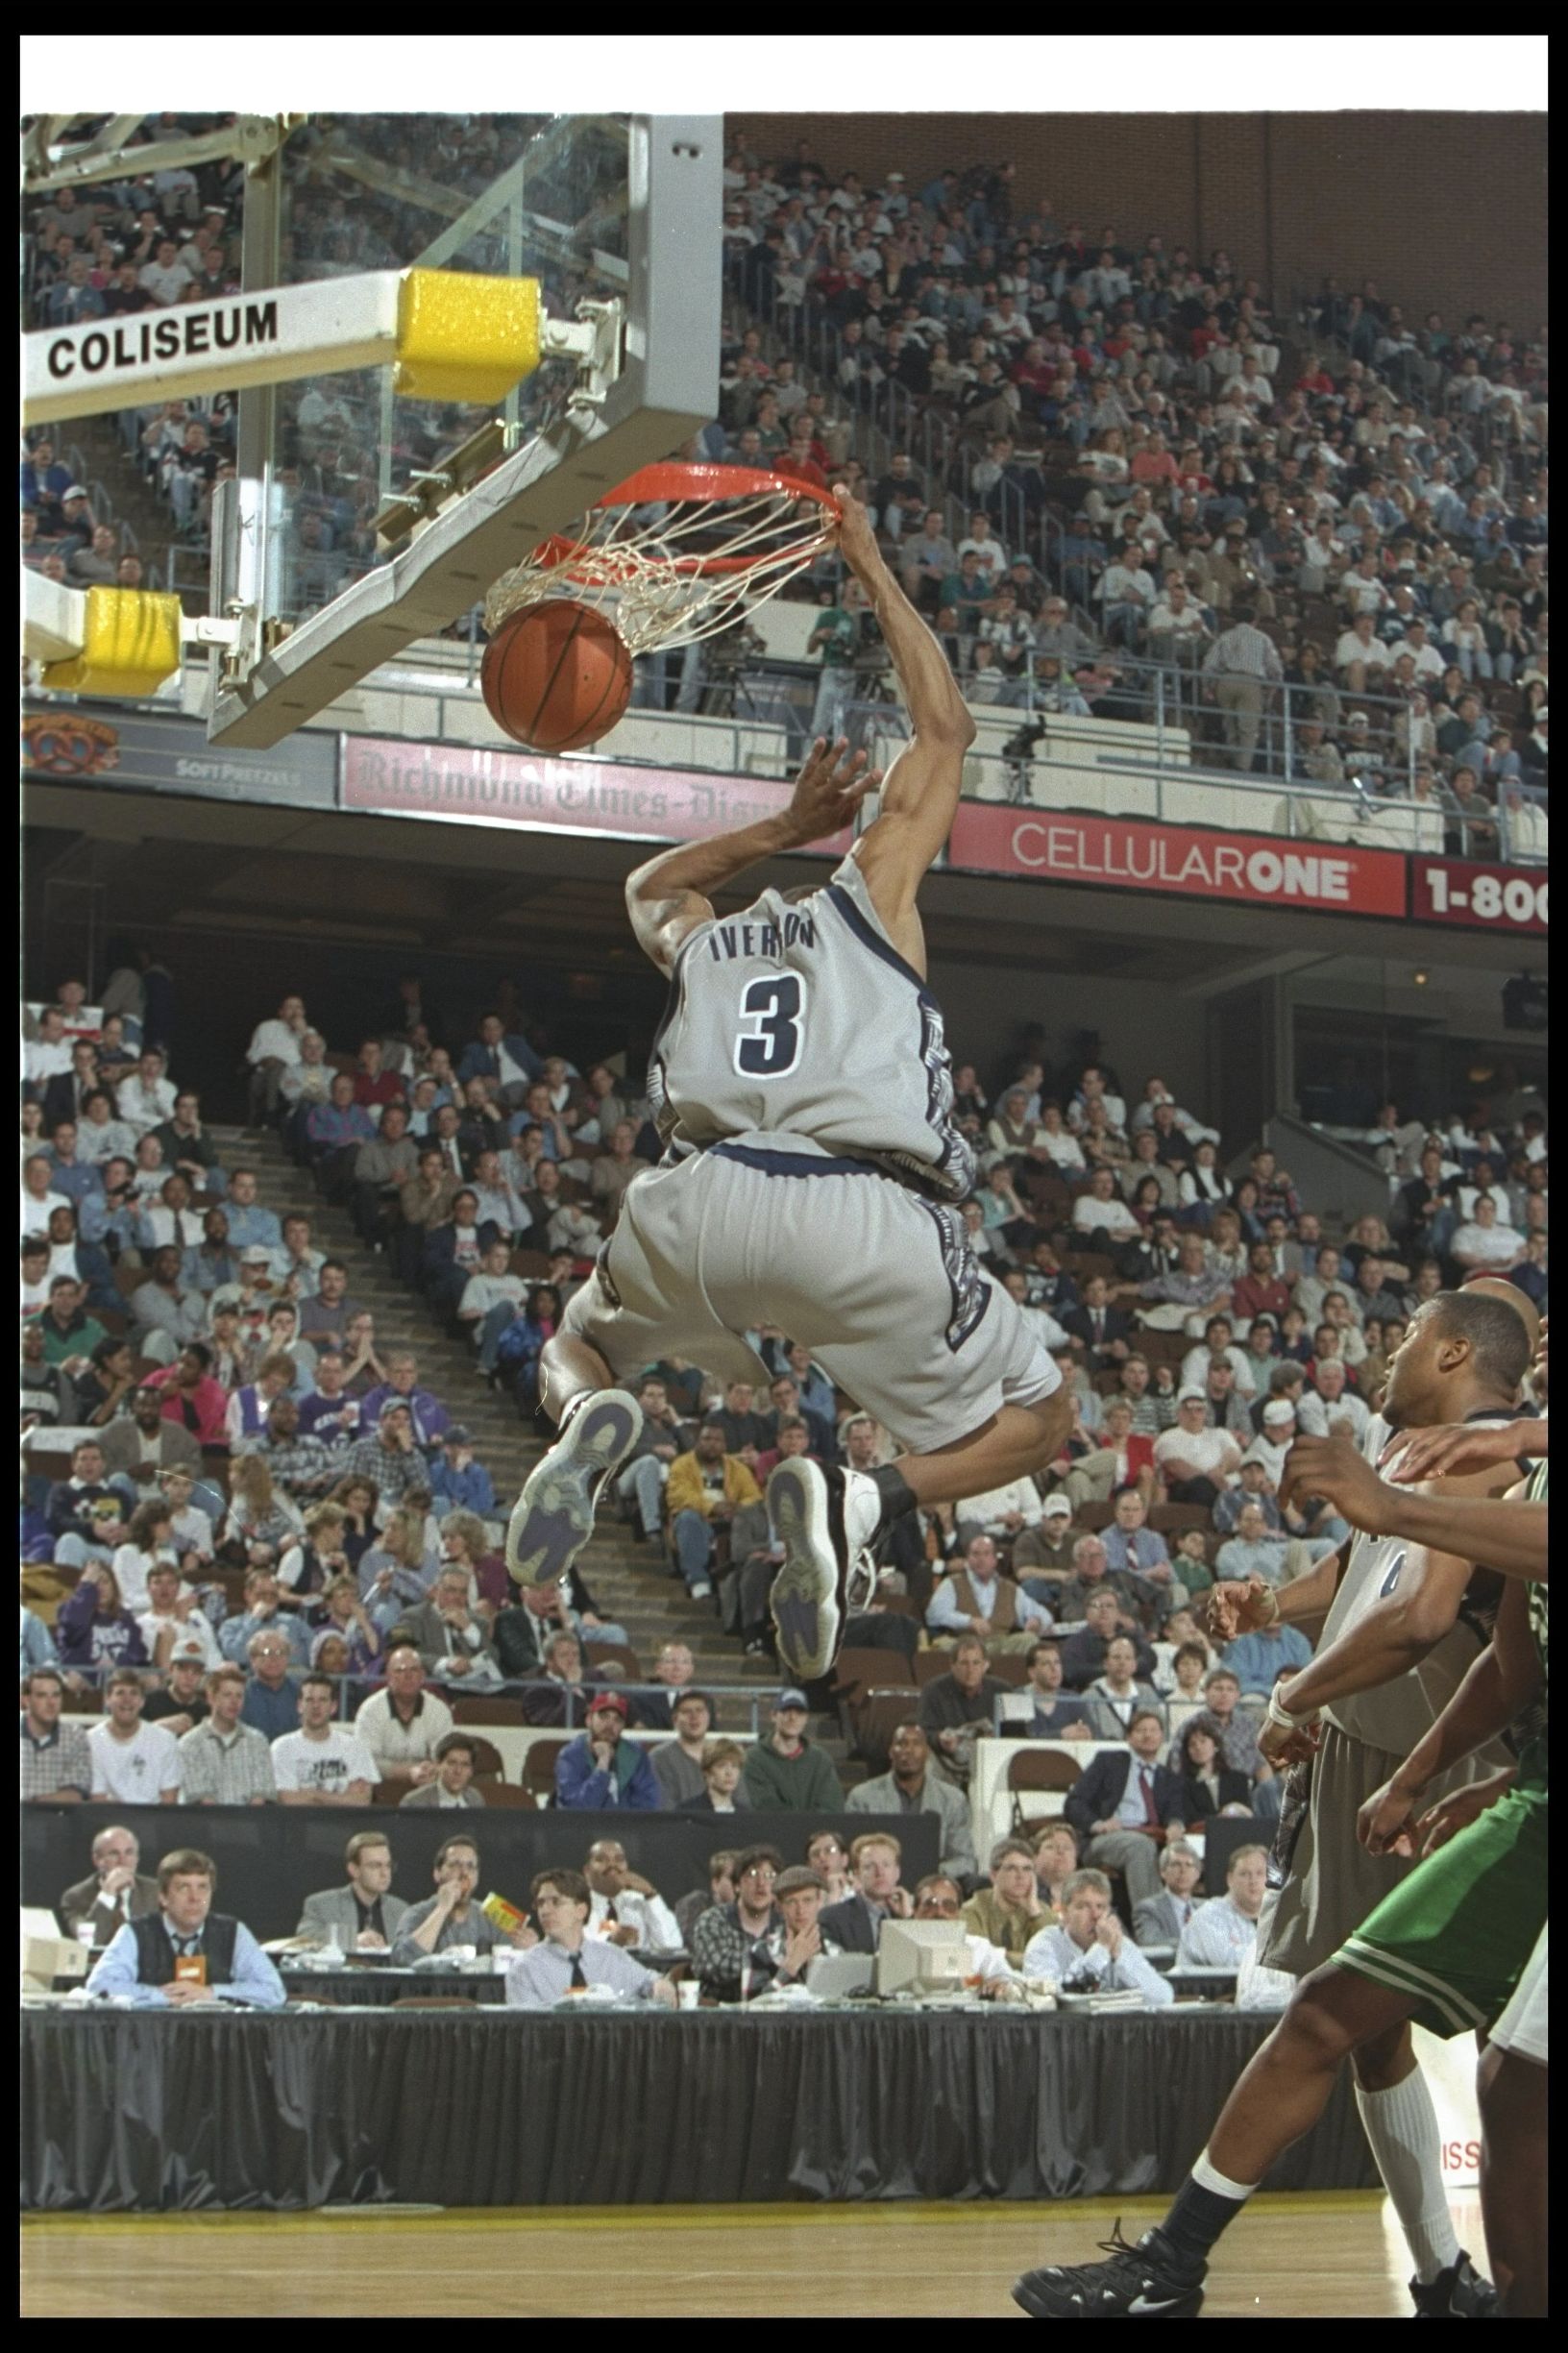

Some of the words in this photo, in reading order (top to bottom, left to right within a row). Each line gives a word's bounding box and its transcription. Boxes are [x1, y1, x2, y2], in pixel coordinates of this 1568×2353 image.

[48, 301, 278, 379] COLISEUM
[357, 749, 545, 808] Richmond
[1012, 822, 1350, 901] CELLULARONE
[709, 912, 815, 962] IVERON
[733, 970, 809, 1081] 3
